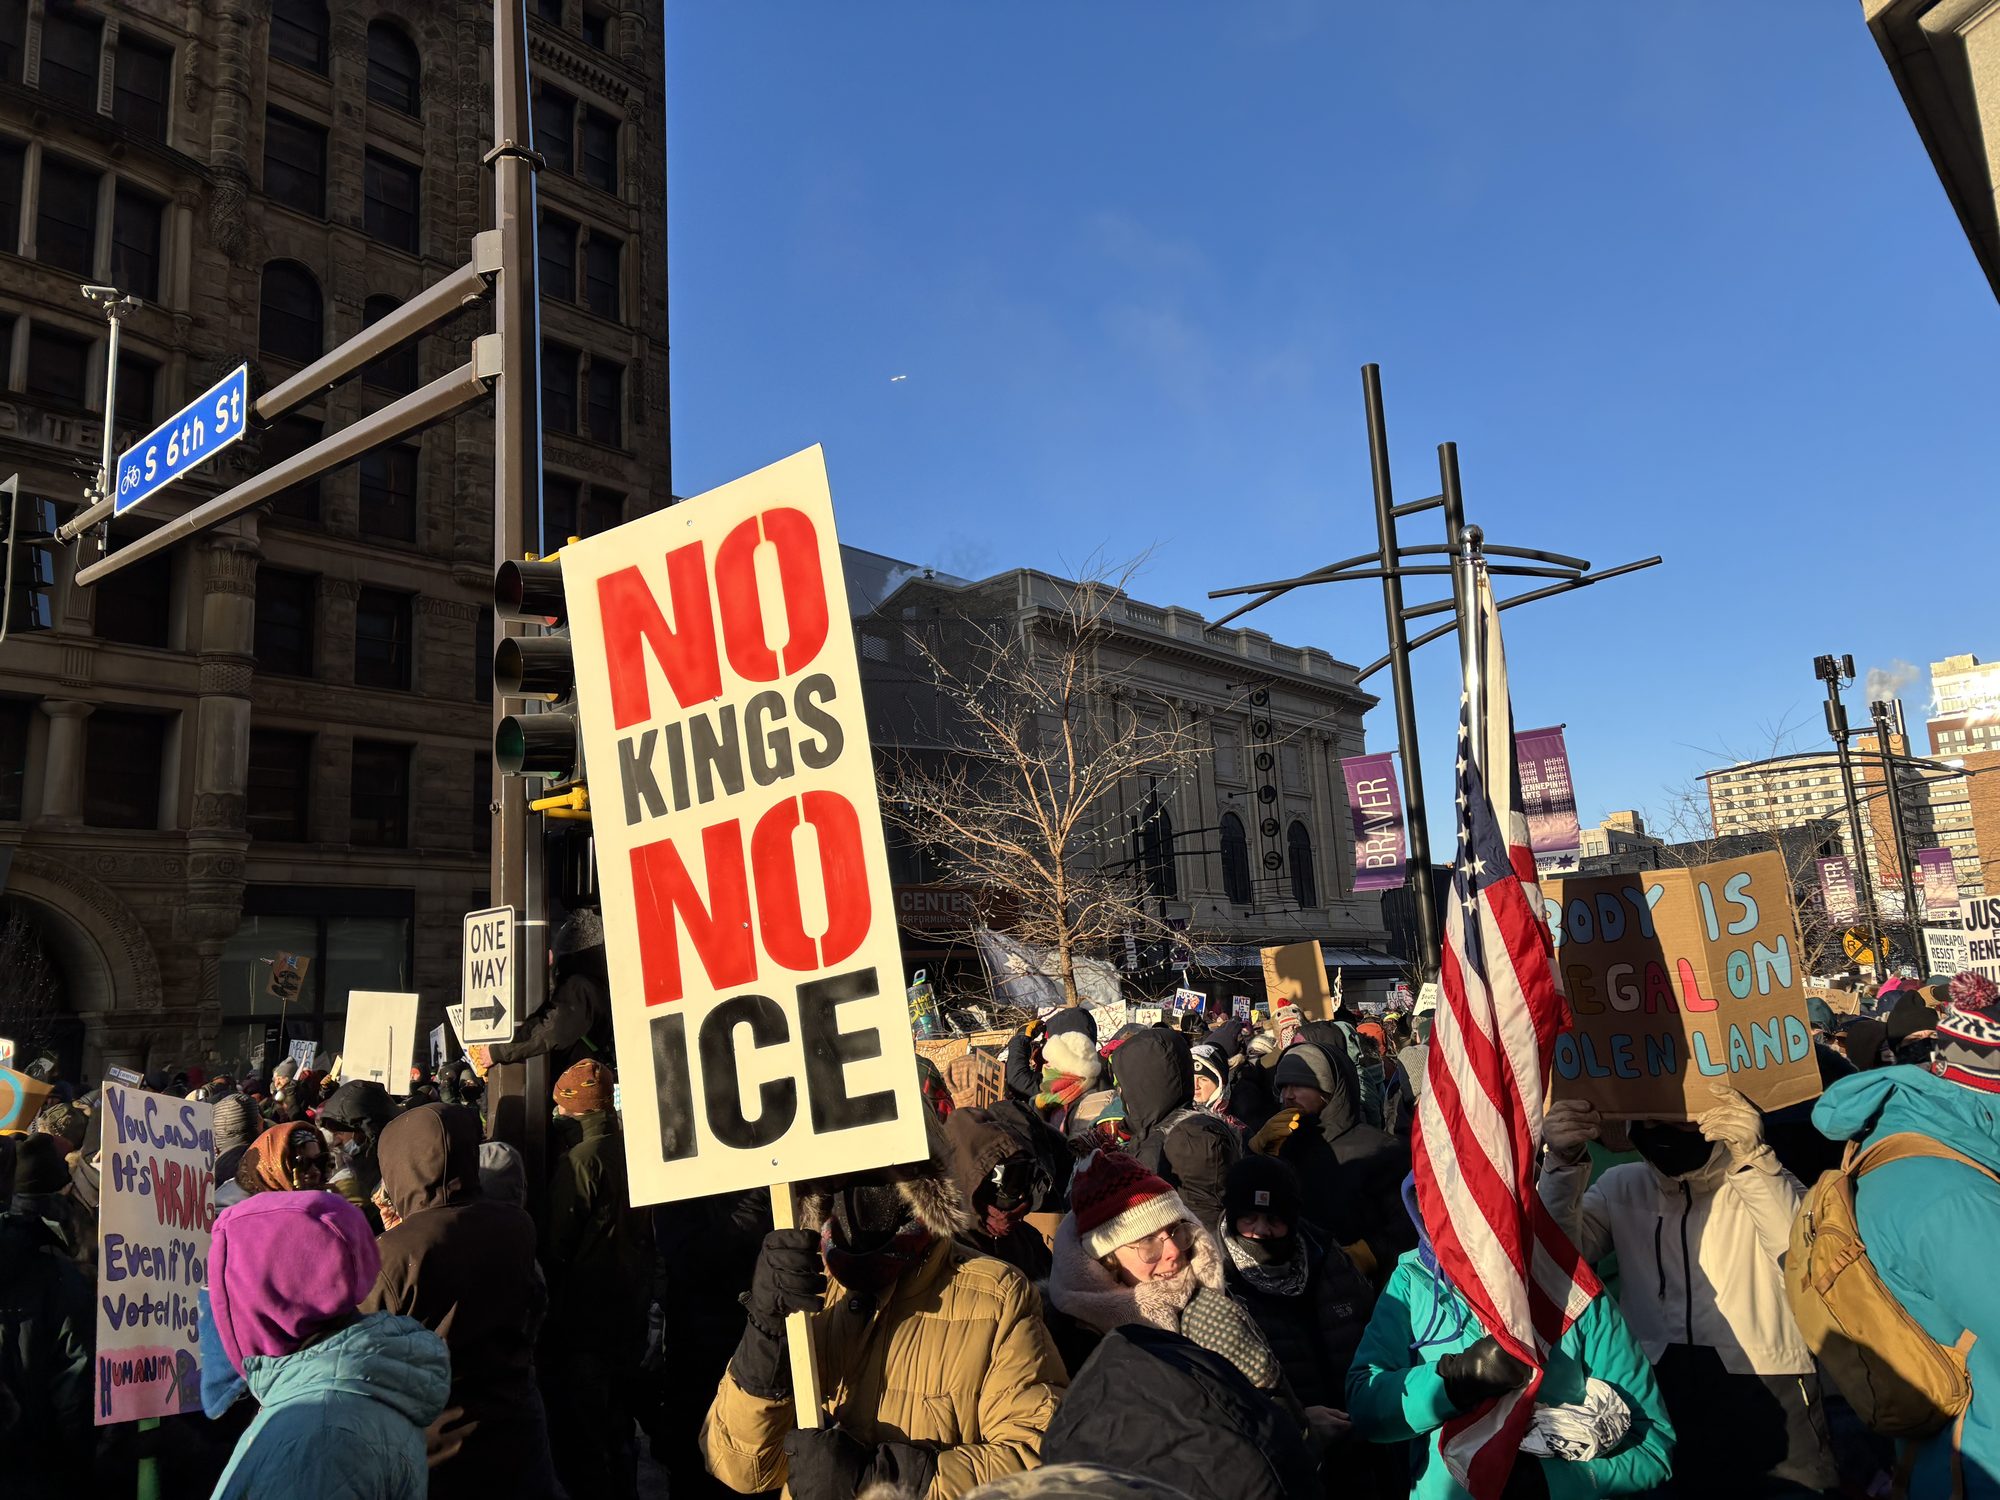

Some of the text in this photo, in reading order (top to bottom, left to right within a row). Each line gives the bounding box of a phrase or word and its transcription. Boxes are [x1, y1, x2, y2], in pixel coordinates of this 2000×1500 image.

[145, 387, 240, 482] S 6th St
[597, 507, 829, 730] NO
[618, 673, 844, 826] KINGS
[1357, 778, 1397, 869] BRAVER
[1522, 791, 1541, 799] ARTS
[629, 790, 872, 1006] NO
[900, 891, 974, 912] CENTER
[1544, 883, 1664, 948] BODY
[1698, 872, 1759, 942] IS
[1824, 861, 1854, 924] BRIGHTER
[471, 920, 506, 953] ONE
[1848, 940, 1857, 951] R
[1931, 947, 1955, 959] RESIST
[1934, 960, 1957, 974] DEFEND
[471, 956, 507, 990] WAY
[1566, 934, 1792, 1015] EGAL ON
[650, 967, 898, 1162] ICE
[977, 1053, 1001, 1091] ICE
[1555, 1015, 1809, 1080] OLEN LAND
[106, 1086, 215, 1171] You Can Say
[112, 1150, 215, 1233] It's WRONG
[105, 1234, 166, 1281] Even
[168, 1238, 181, 1282] if
[103, 1292, 170, 1330] Voted
